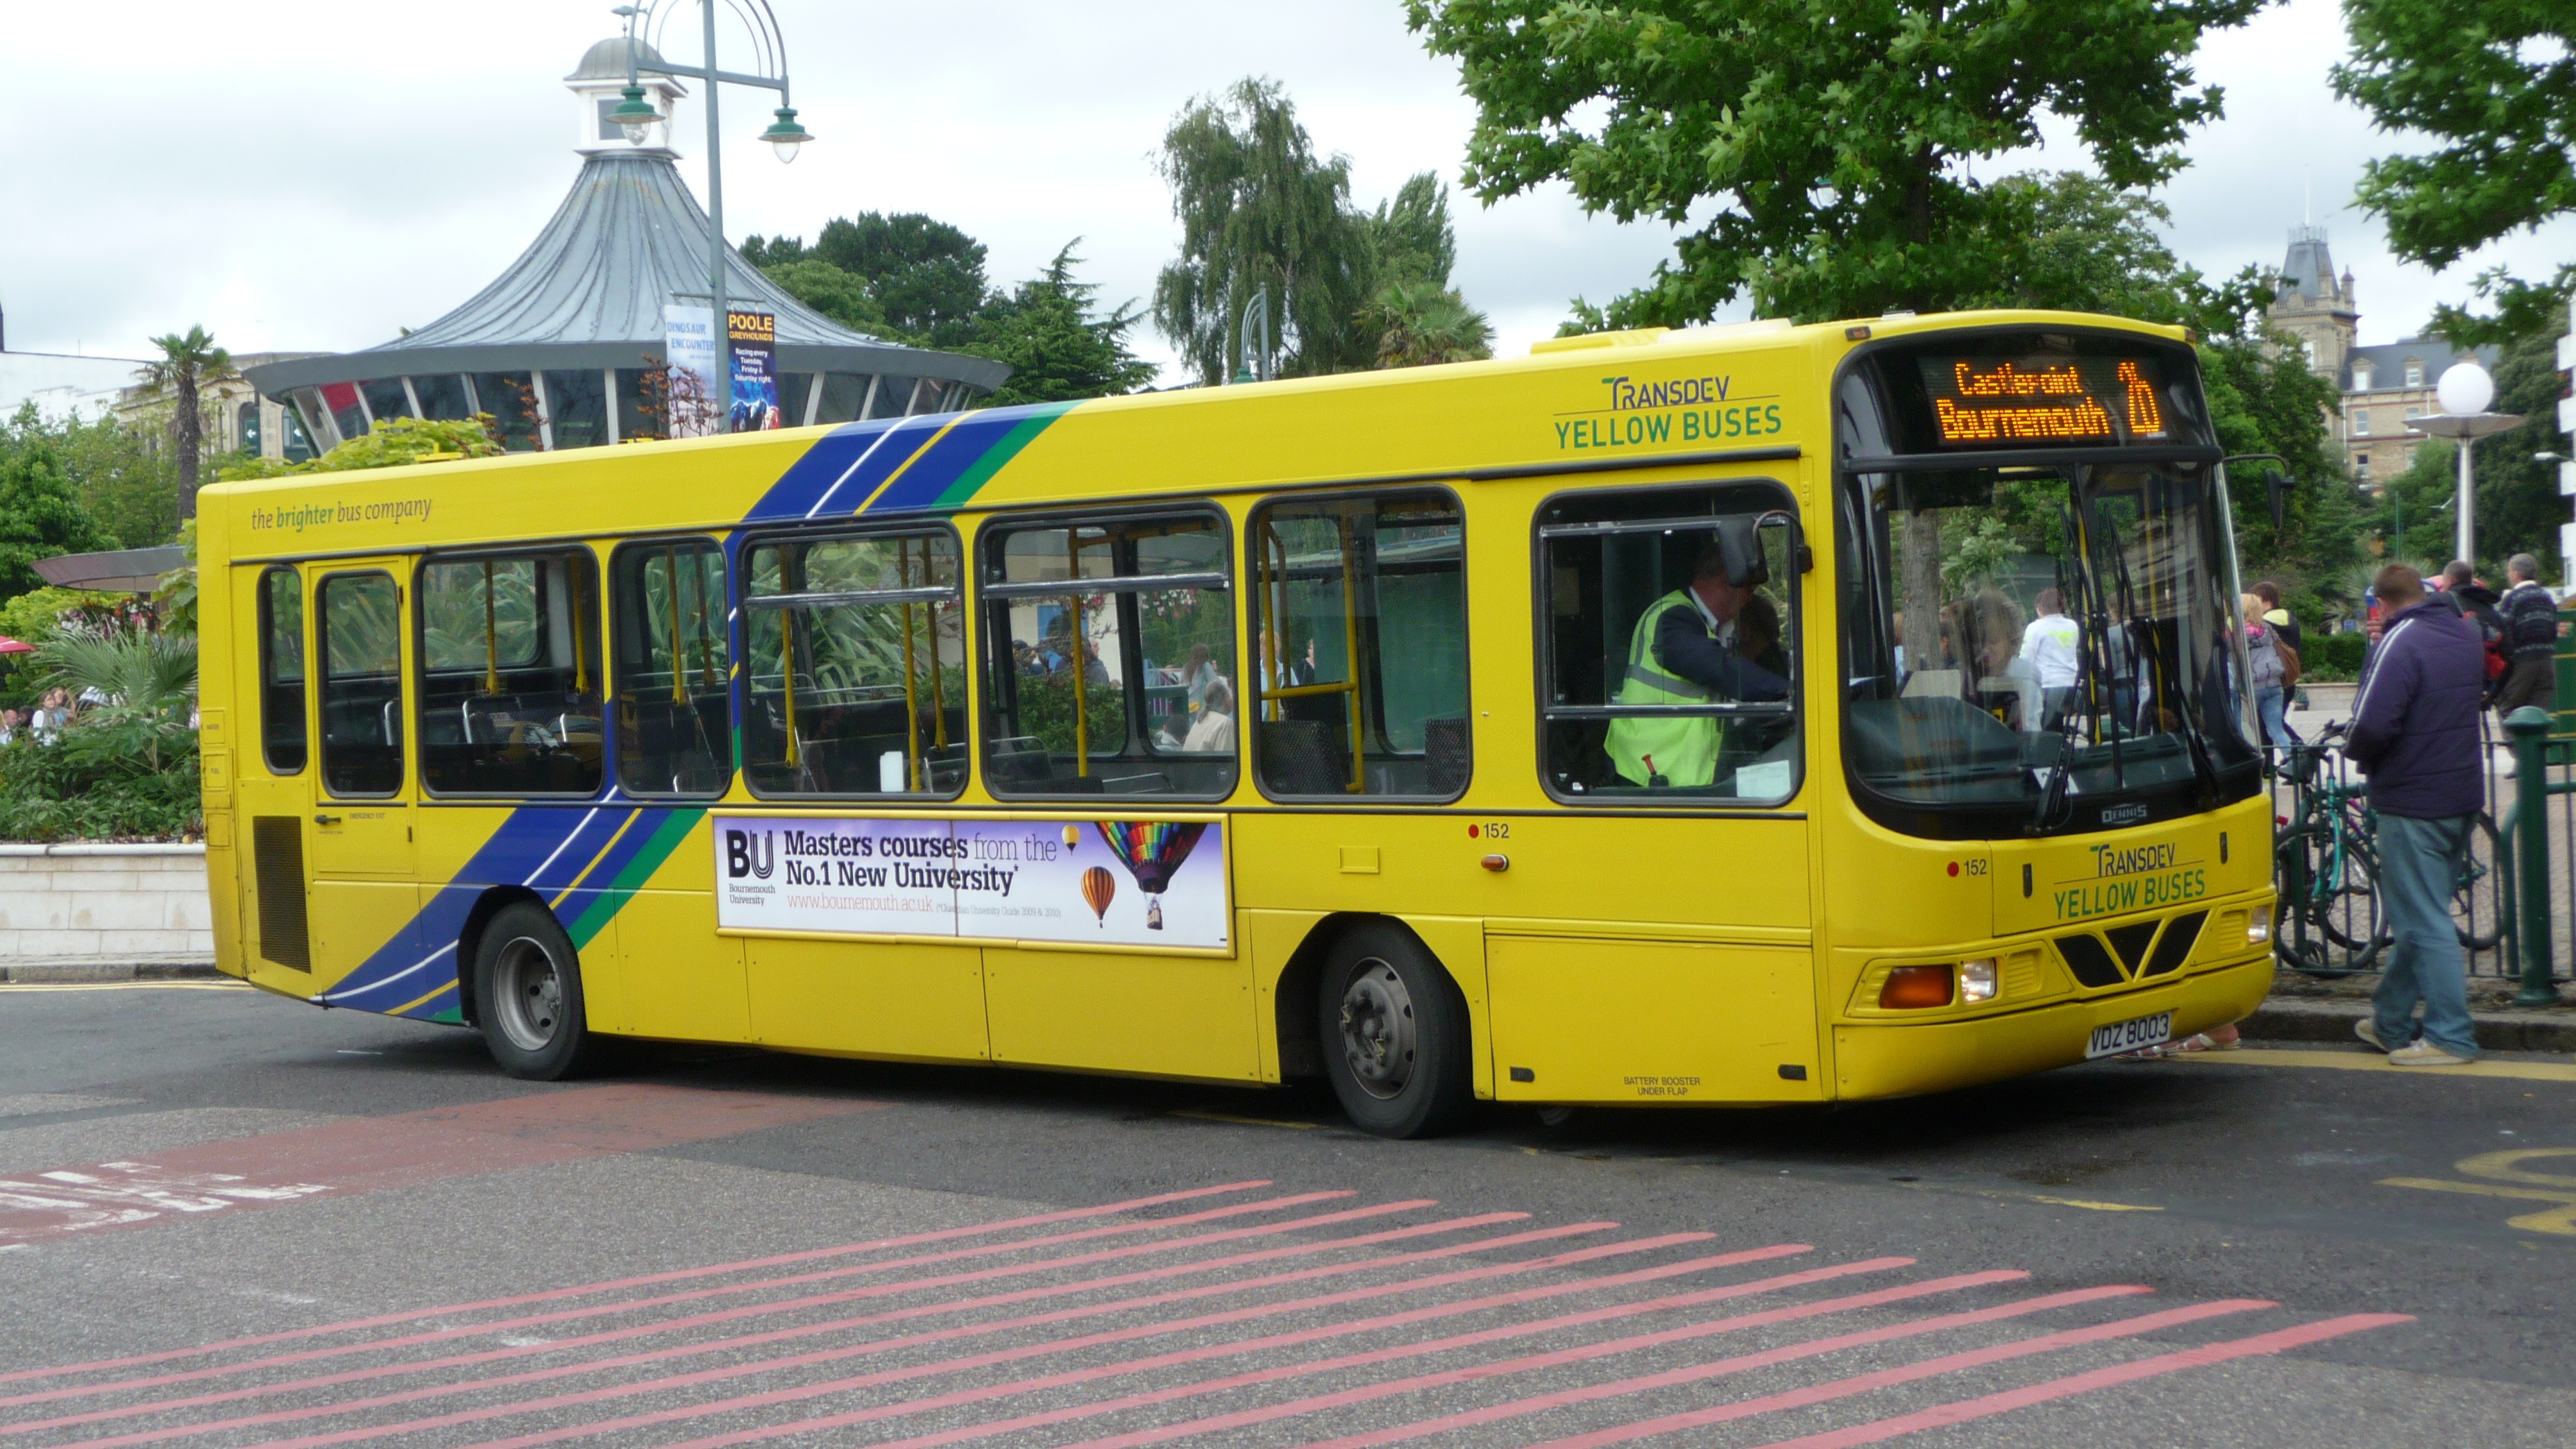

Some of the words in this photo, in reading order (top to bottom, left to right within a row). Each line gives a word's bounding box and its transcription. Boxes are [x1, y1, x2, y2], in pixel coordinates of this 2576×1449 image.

[667, 322, 706, 334] DINOSAUR
[729, 314, 772, 331] POOLE
[672, 338, 714, 350] ENCOUNTER
[729, 331, 773, 341] GREYHOUNDS
[736, 348, 753, 357] Racing
[741, 366, 758, 374] Friday
[1956, 362, 2083, 396] Castlepoint
[1601, 375, 1730, 411] TRANSDEV
[1936, 396, 2110, 439] Bournemouth
[1554, 414, 1672, 450] YELLOW
[1683, 405, 1782, 441] BUSES
[251, 508, 273, 530] the
[276, 504, 334, 532] brighter
[337, 500, 362, 523] bus
[364, 498, 432, 525] company
[1483, 823, 1510, 838] 152
[726, 829, 774, 880] BU
[783, 830, 872, 856] Masters
[879, 835, 968, 859] courses
[974, 832, 1017, 860] from
[1024, 834, 1058, 861] the
[1963, 858, 1988, 876] 152
[2090, 842, 2176, 878] TRANSDEV
[785, 860, 832, 886] No.1
[837, 861, 888, 888] New
[729, 883, 776, 894] Bournemouth
[2054, 879, 2138, 920] YELLOW
[2144, 869, 2205, 905] BUSES
[729, 894, 765, 906] University
[787, 892, 933, 912] www.bournemouth.ac.uk
[936, 903, 969, 914] (Guadian
[970, 905, 1000, 917] University
[1001, 906, 1020, 916] Guide
[1022, 906, 1036, 916] 2009
[2092, 1022, 2123, 1052] VDZ
[2127, 1013, 2169, 1044] 8003
[1624, 1076, 1659, 1085] BATTERY
[1661, 1076, 1701, 1086] BOOSTER
[1638, 1087, 1665, 1096] UNDER
[1668, 1087, 1688, 1096] FLAP
